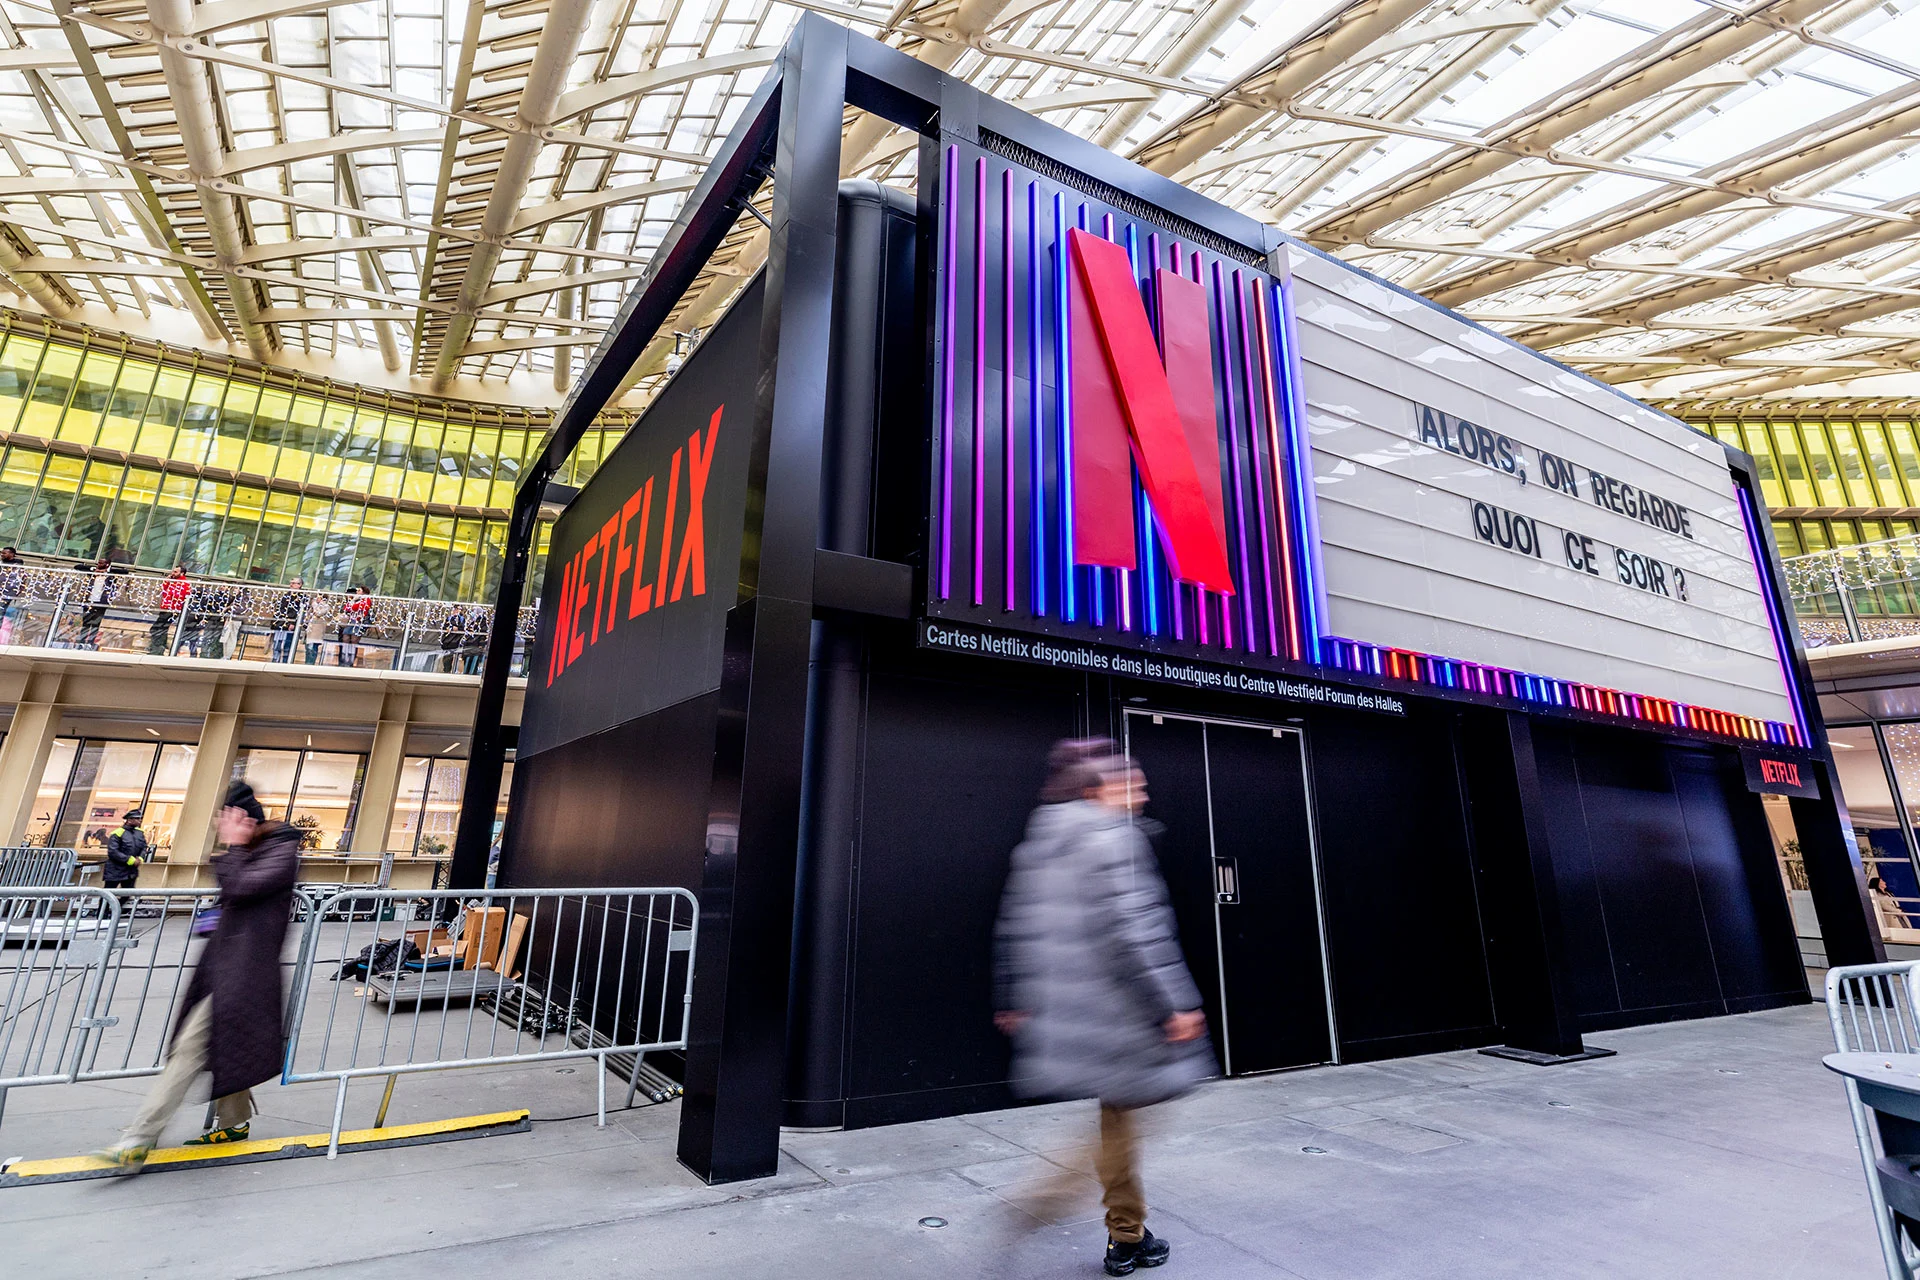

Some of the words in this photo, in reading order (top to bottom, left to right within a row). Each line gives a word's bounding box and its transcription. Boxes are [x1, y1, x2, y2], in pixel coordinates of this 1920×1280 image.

[1066, 226, 1236, 596] N
[1421, 406, 1528, 486] ALORS,
[1541, 454, 1579, 498] ON
[1591, 471, 1694, 540] REGARDE
[546, 403, 725, 689] NETFLIX
[1473, 502, 1542, 559] QUOI
[1565, 532, 1600, 576] CE
[1615, 548, 1670, 598] SOIR
[1674, 567, 1688, 602] ?
[926, 625, 978, 649] Cartes
[981, 633, 1029, 657] Netflix
[1031, 642, 1109, 668] disponibles
[1112, 654, 1143, 674] dans
[1144, 660, 1162, 677] les
[1164, 662, 1222, 686] boutiques
[1223, 675, 1238, 689] du
[1239, 676, 1275, 694] Centre
[1276, 680, 1324, 702] Westfield
[1325, 687, 1356, 706] Forum
[1357, 692, 1374, 709] des
[1375, 694, 1404, 713] Halles
[1760, 759, 1802, 788] NETFLIX
